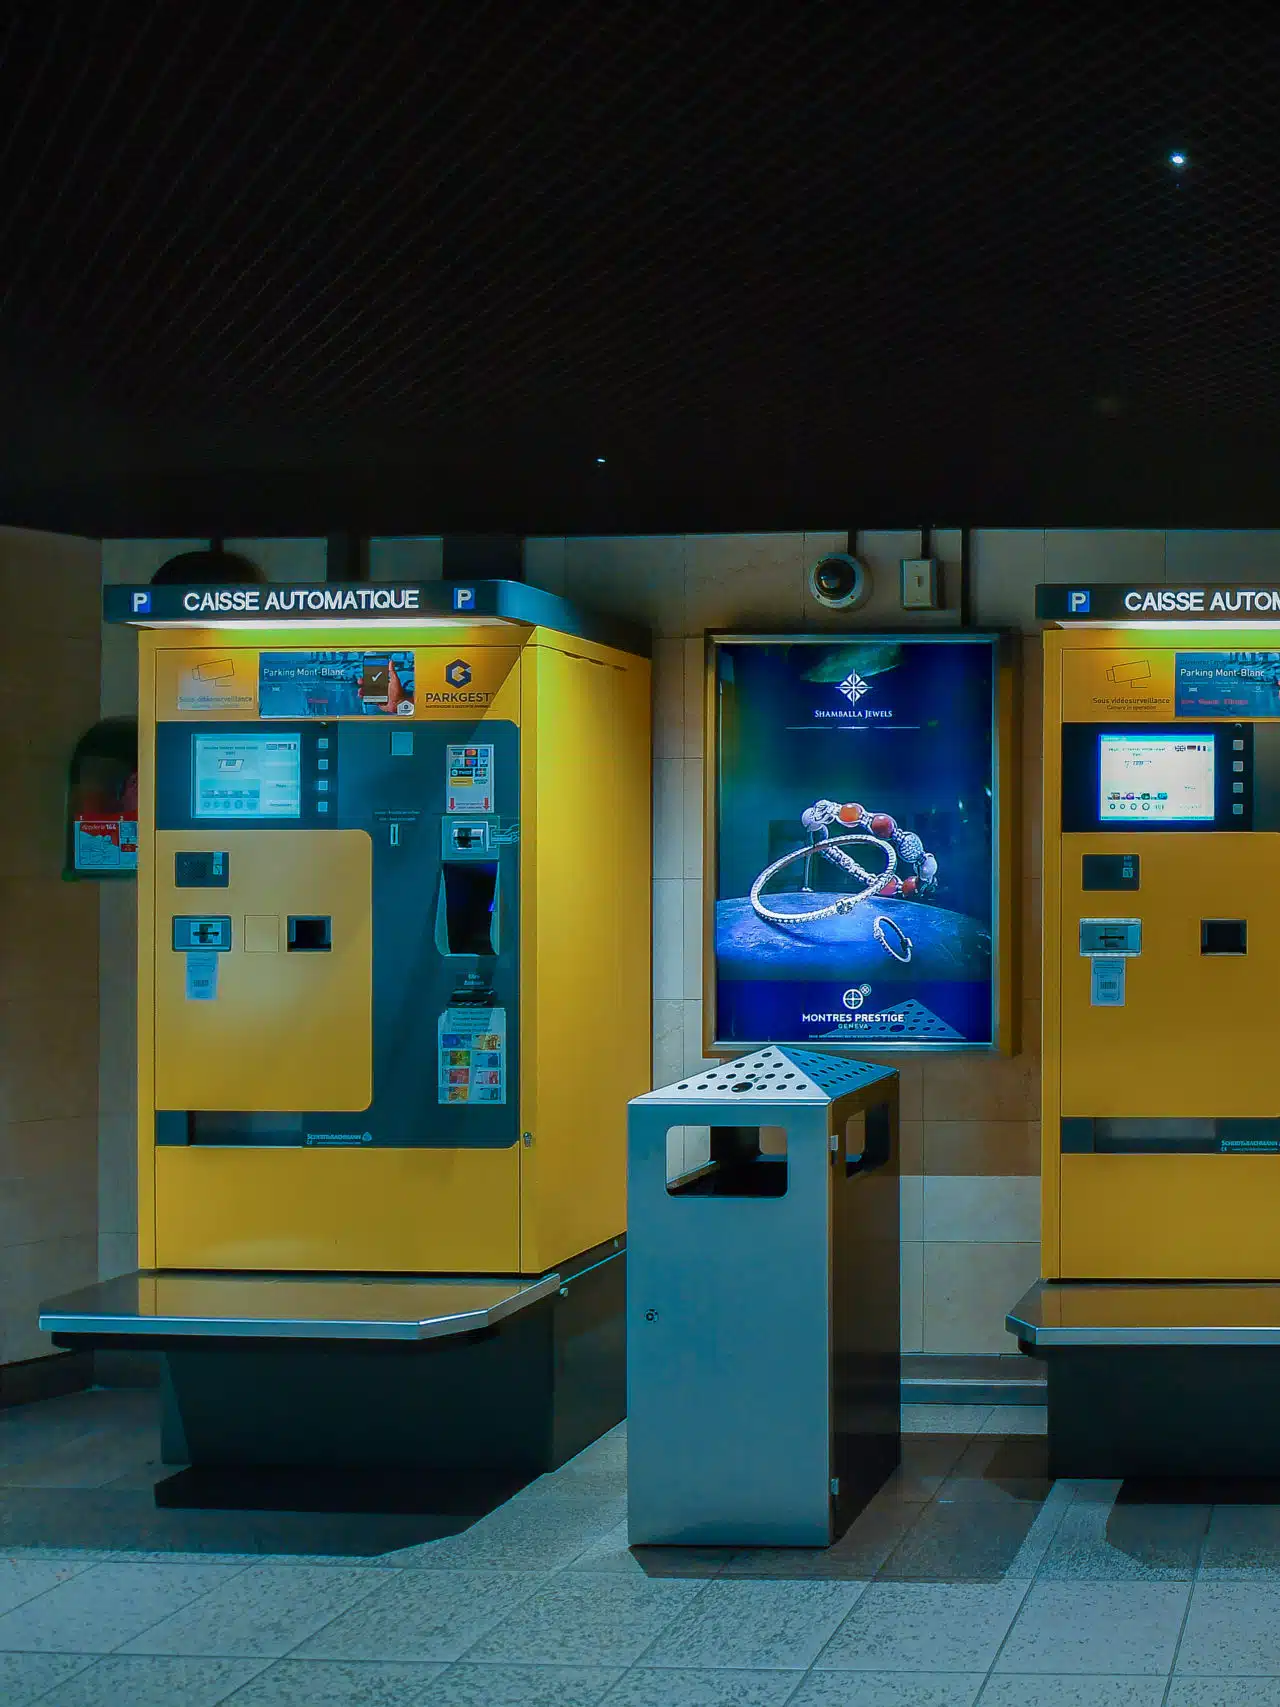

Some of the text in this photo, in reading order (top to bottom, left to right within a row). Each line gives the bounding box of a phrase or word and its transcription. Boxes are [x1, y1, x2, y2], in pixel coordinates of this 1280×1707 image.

[133, 593, 147, 611] P
[184, 590, 420, 611] CAISSE AUTOMATIQUE
[458, 590, 472, 608] P
[1072, 592, 1086, 610] P
[1125, 592, 1204, 611] CAISSE
[264, 667, 345, 678] Parking Mont-Blanc
[1180, 668, 1264, 679] Parking Mont-Blanc
[425, 692, 491, 703] PARKGEST
[814, 709, 892, 719] SHAMBALLA JEWELS
[802, 1013, 904, 1022] MONTRES PRESTIGE
